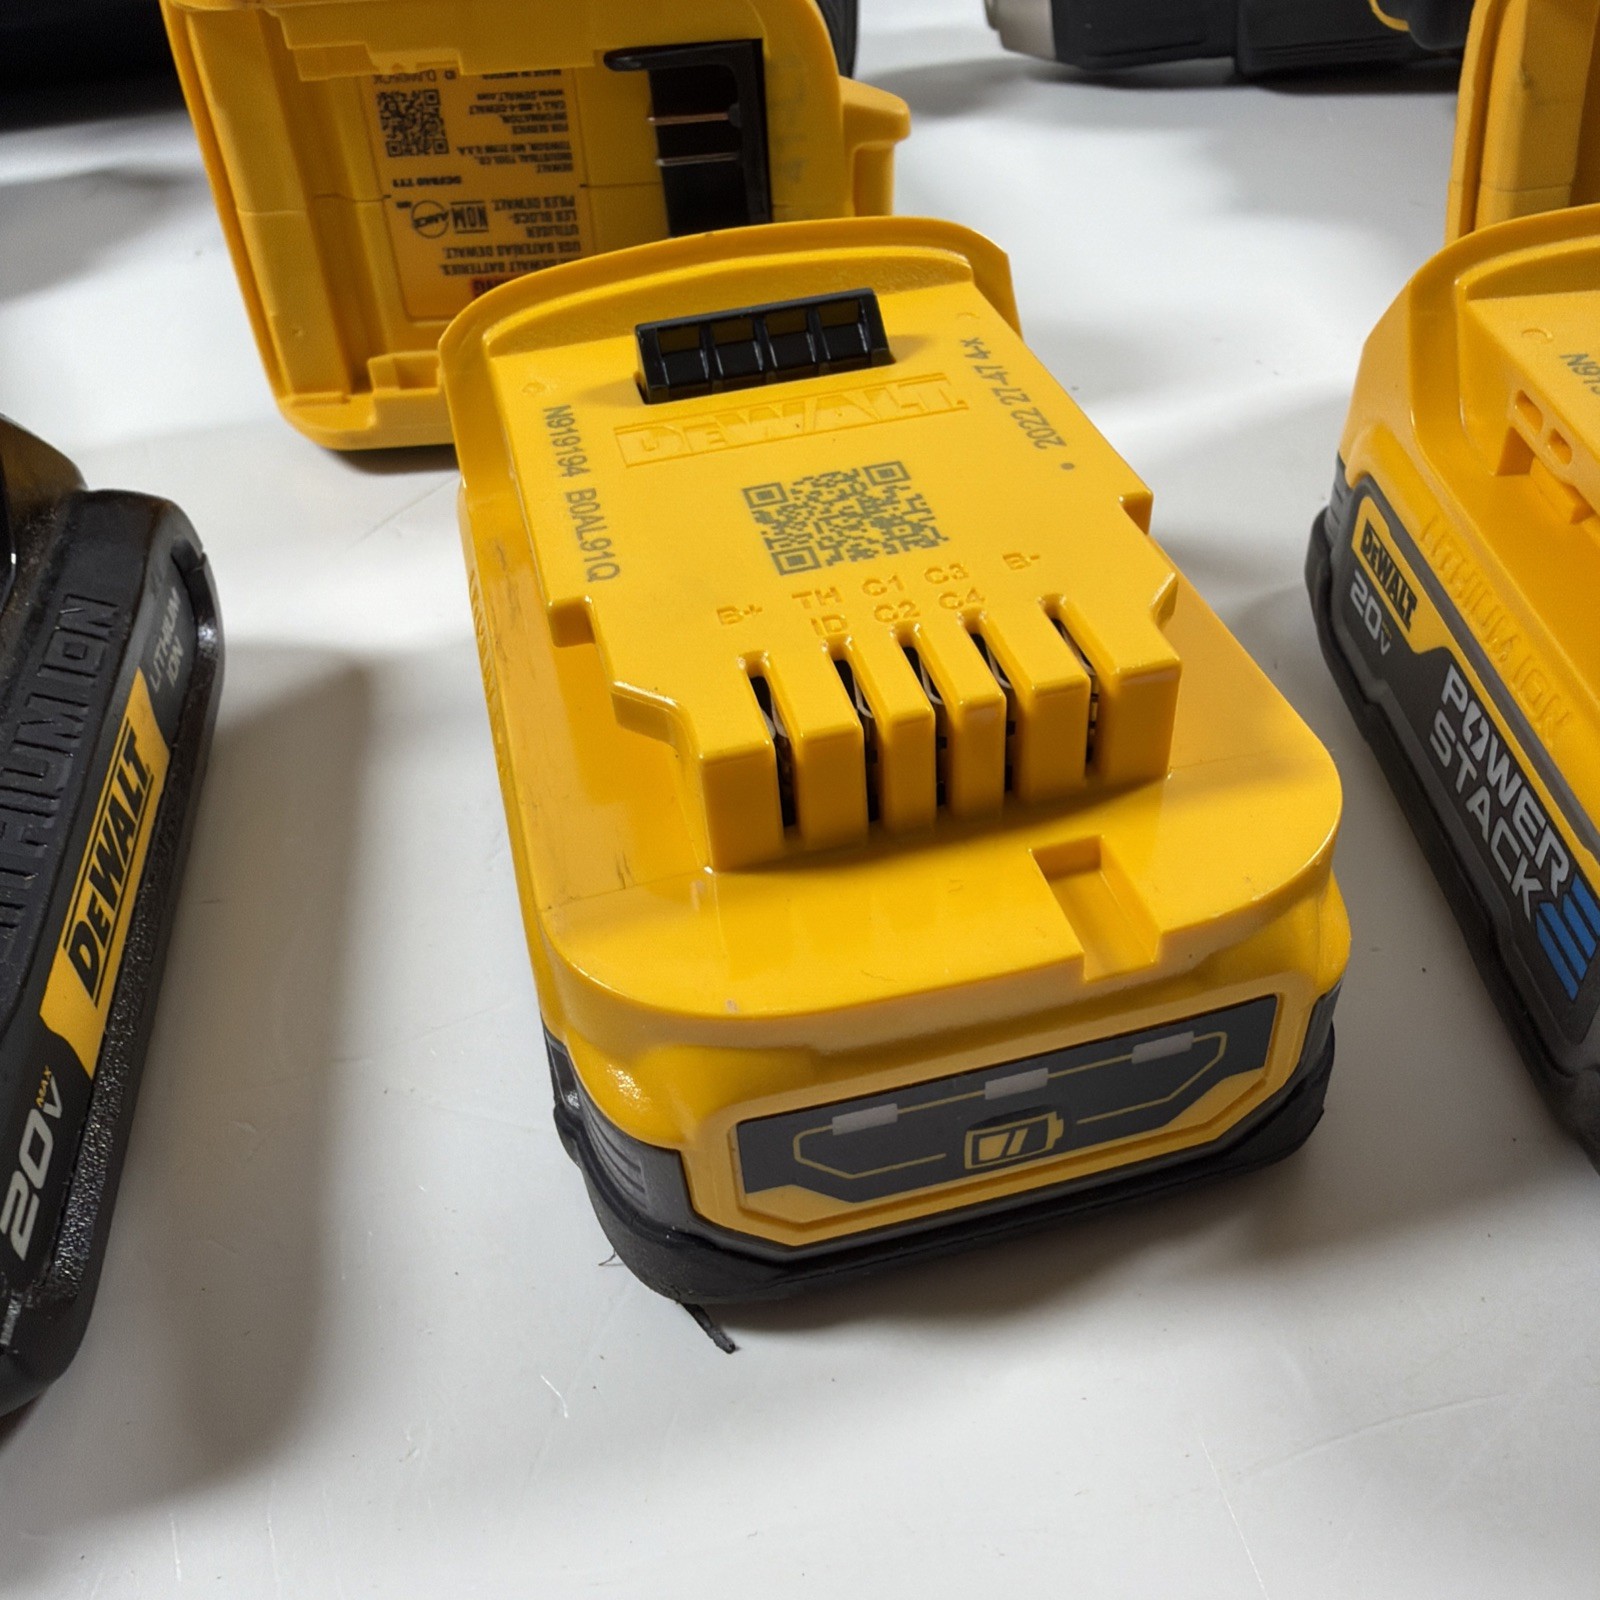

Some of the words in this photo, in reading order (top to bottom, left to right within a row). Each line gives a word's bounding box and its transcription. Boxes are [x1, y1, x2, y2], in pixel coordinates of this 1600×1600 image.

[450, 204, 488, 229] NOM
[612, 371, 970, 467] DEWALT
[1010, 407, 1068, 450] 2022
[543, 404, 591, 478] N919194
[923, 562, 970, 585] C3
[1002, 551, 1041, 570] B-
[1359, 517, 1418, 633] DEWALT
[791, 585, 842, 609] TH
[861, 573, 905, 597] C1
[938, 586, 987, 610] C4
[716, 603, 763, 626] B+
[810, 613, 849, 637] ID
[873, 599, 922, 623] C2
[36, 592, 120, 680] ION
[150, 586, 181, 694] LITHIUM
[166, 634, 185, 689] ION
[1441, 663, 1571, 899] POWER
[1429, 709, 1544, 923] STACK
[65, 718, 152, 1004] DEWALT
